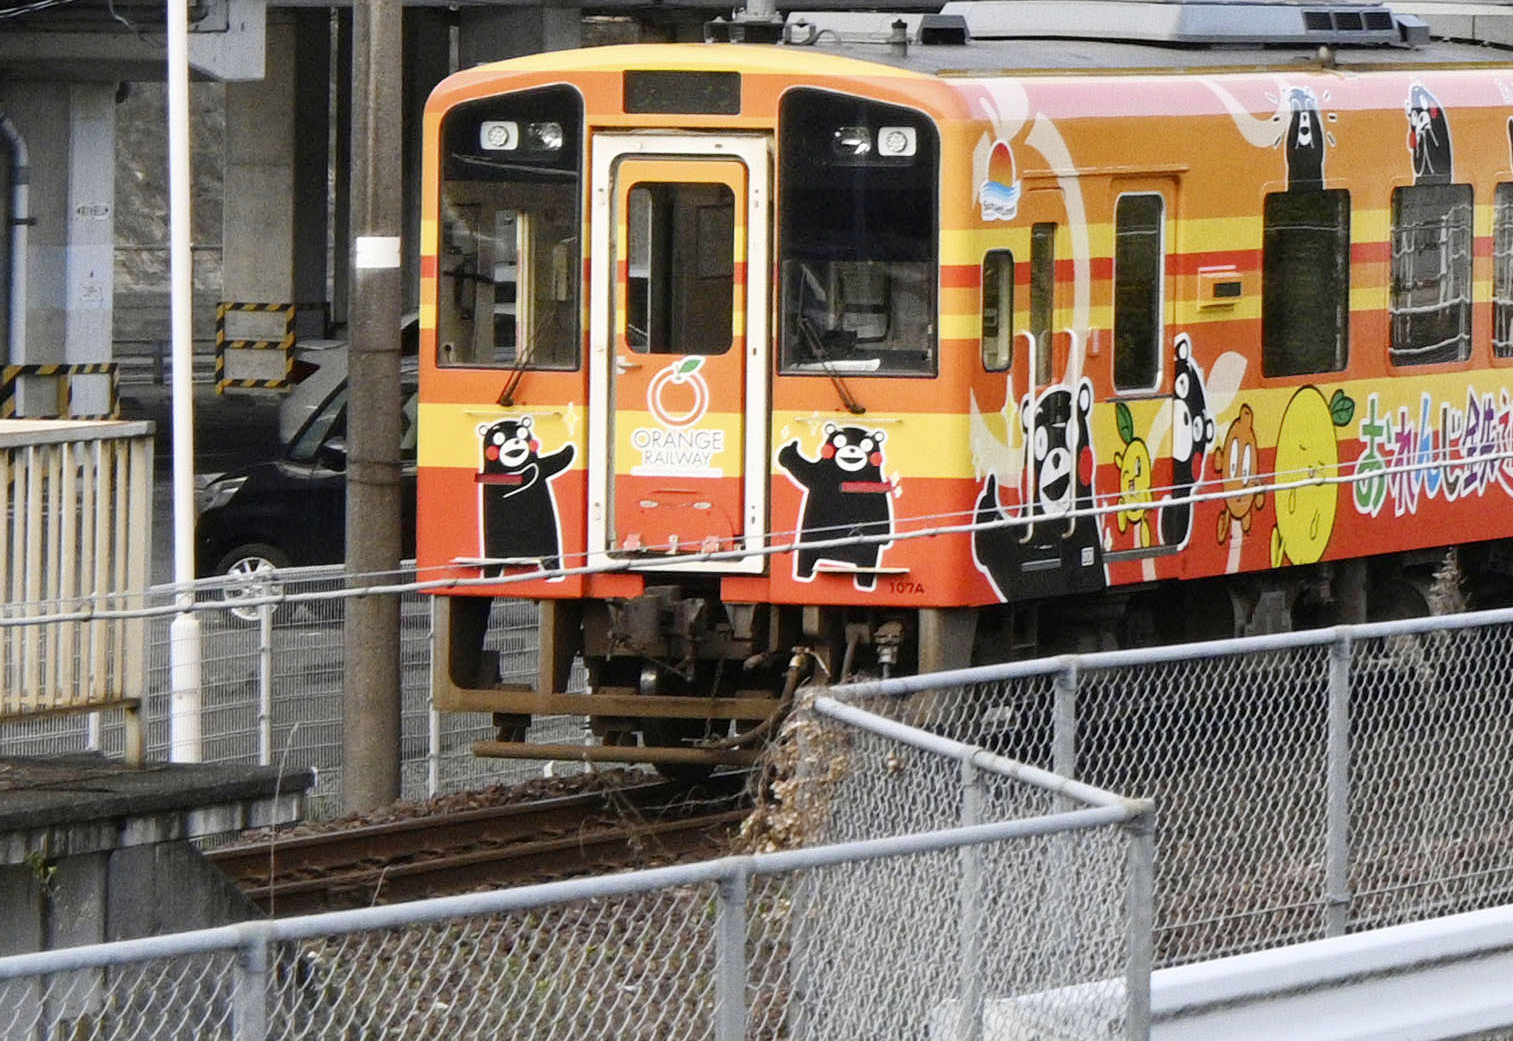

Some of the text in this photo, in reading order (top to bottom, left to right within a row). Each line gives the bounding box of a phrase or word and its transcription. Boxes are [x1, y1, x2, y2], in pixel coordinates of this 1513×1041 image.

[633, 430, 722, 450] ORANGE
[645, 450, 711, 465] RAILWAY
[890, 582, 925, 594] 107A
